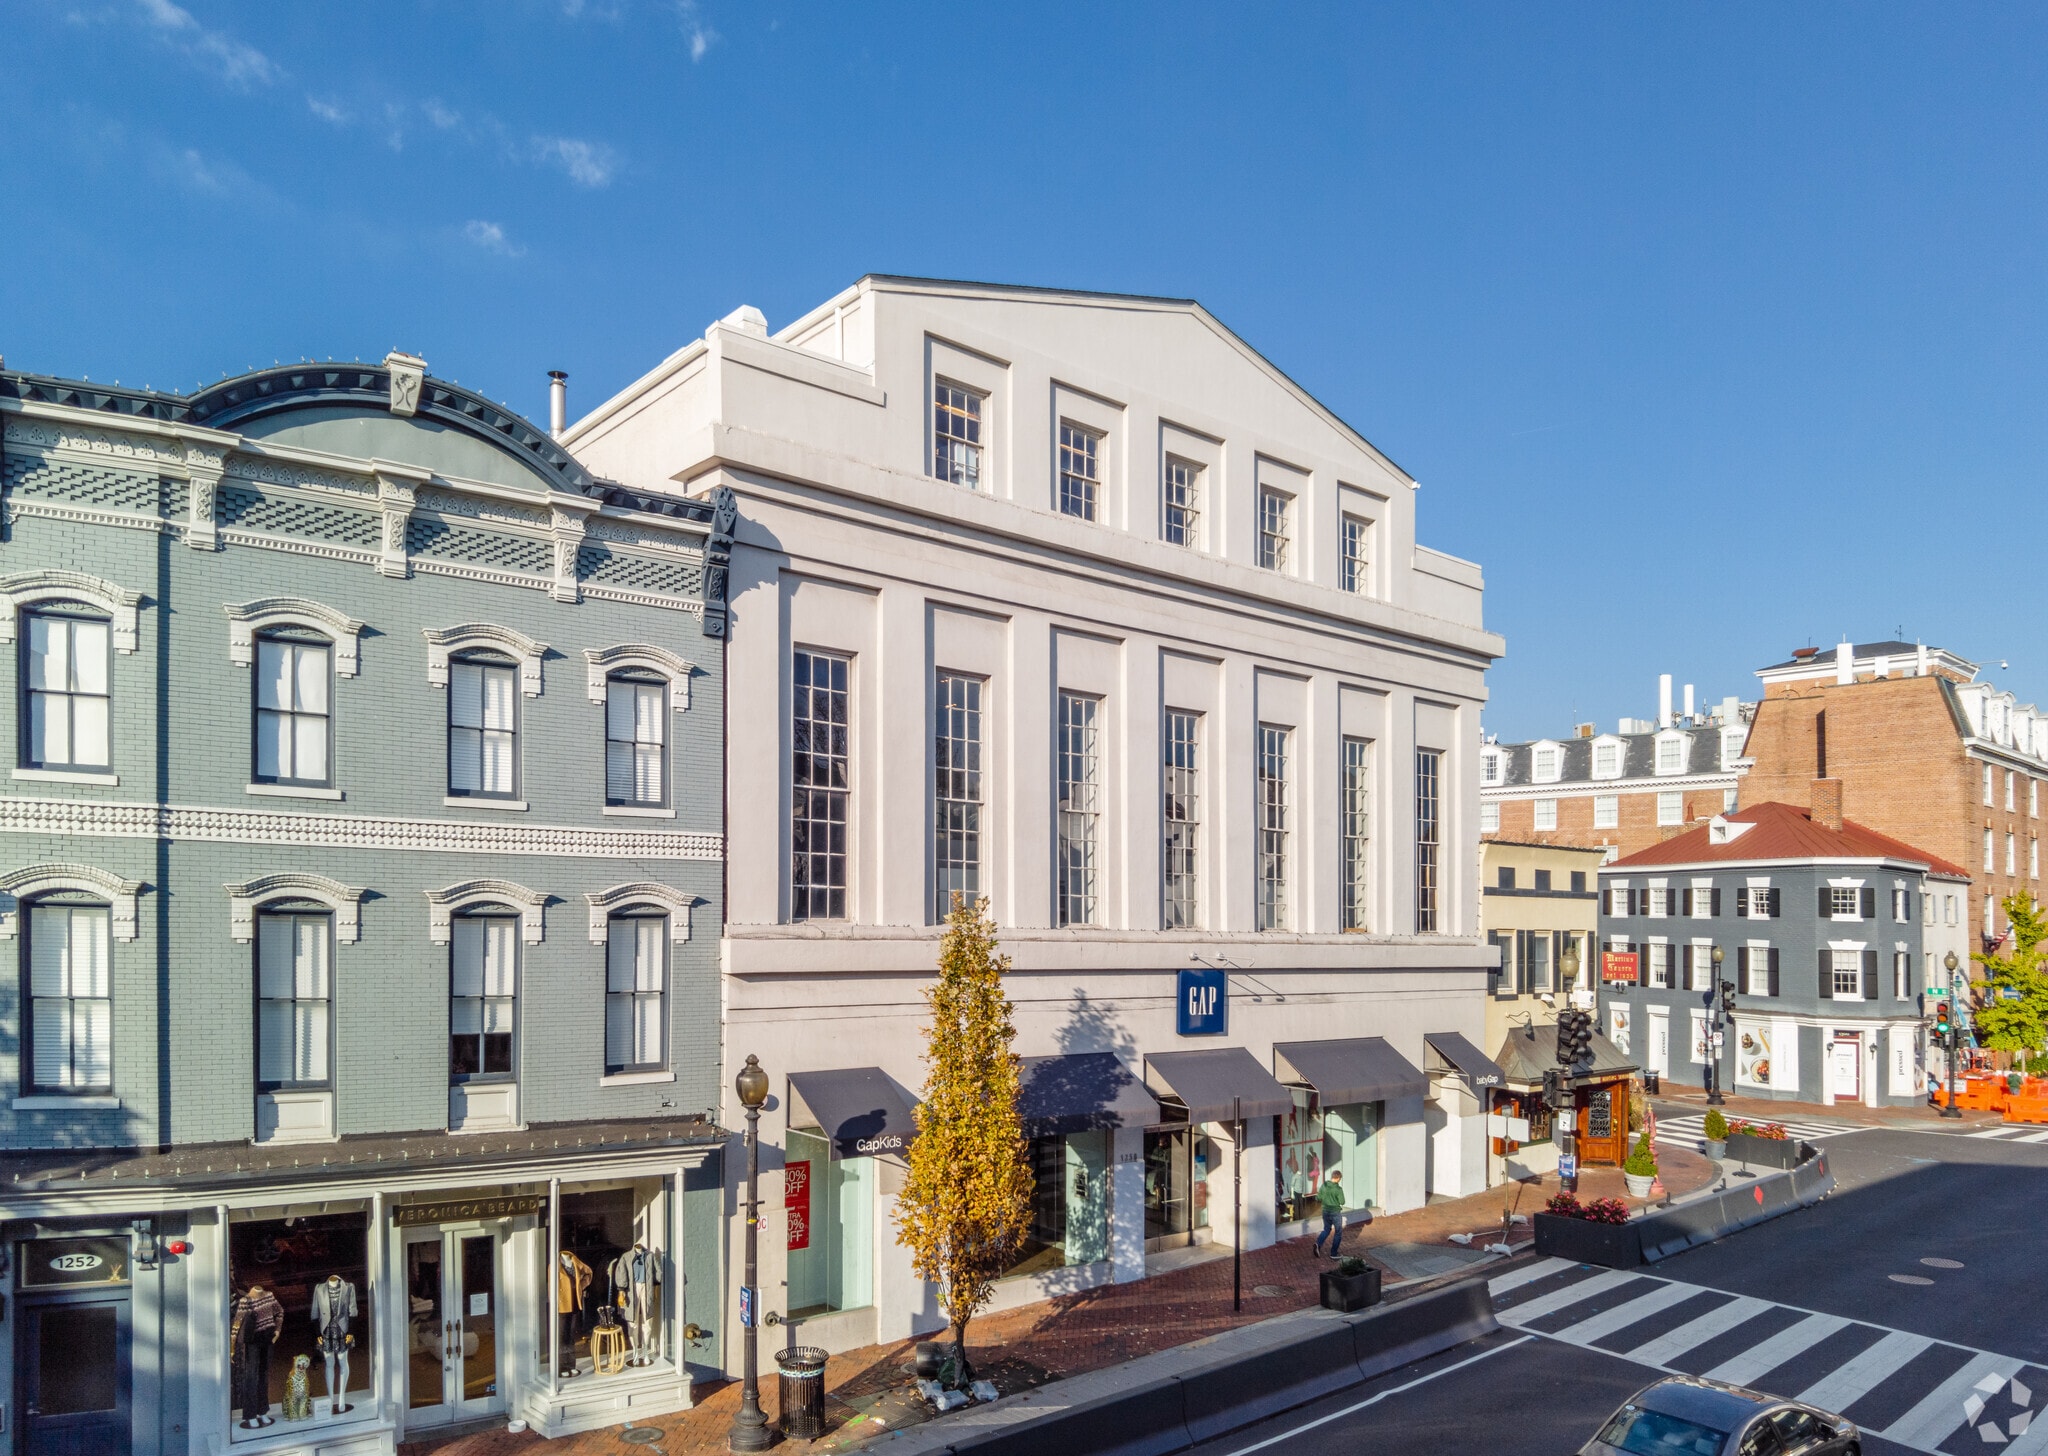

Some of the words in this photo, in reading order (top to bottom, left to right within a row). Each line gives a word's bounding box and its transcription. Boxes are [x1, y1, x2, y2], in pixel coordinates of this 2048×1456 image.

[1189, 986, 1217, 1016] GAP
[1896, 1050, 1905, 1076] pressed
[1476, 1074, 1499, 1086] babyGap
[856, 1135, 902, 1153] GapKids
[398, 1203, 481, 1222] VERONICA
[488, 1200, 539, 1214] BEARD
[787, 1212, 801, 1220] TRA
[787, 1218, 805, 1231] 0%
[57, 1255, 95, 1269] 1252
